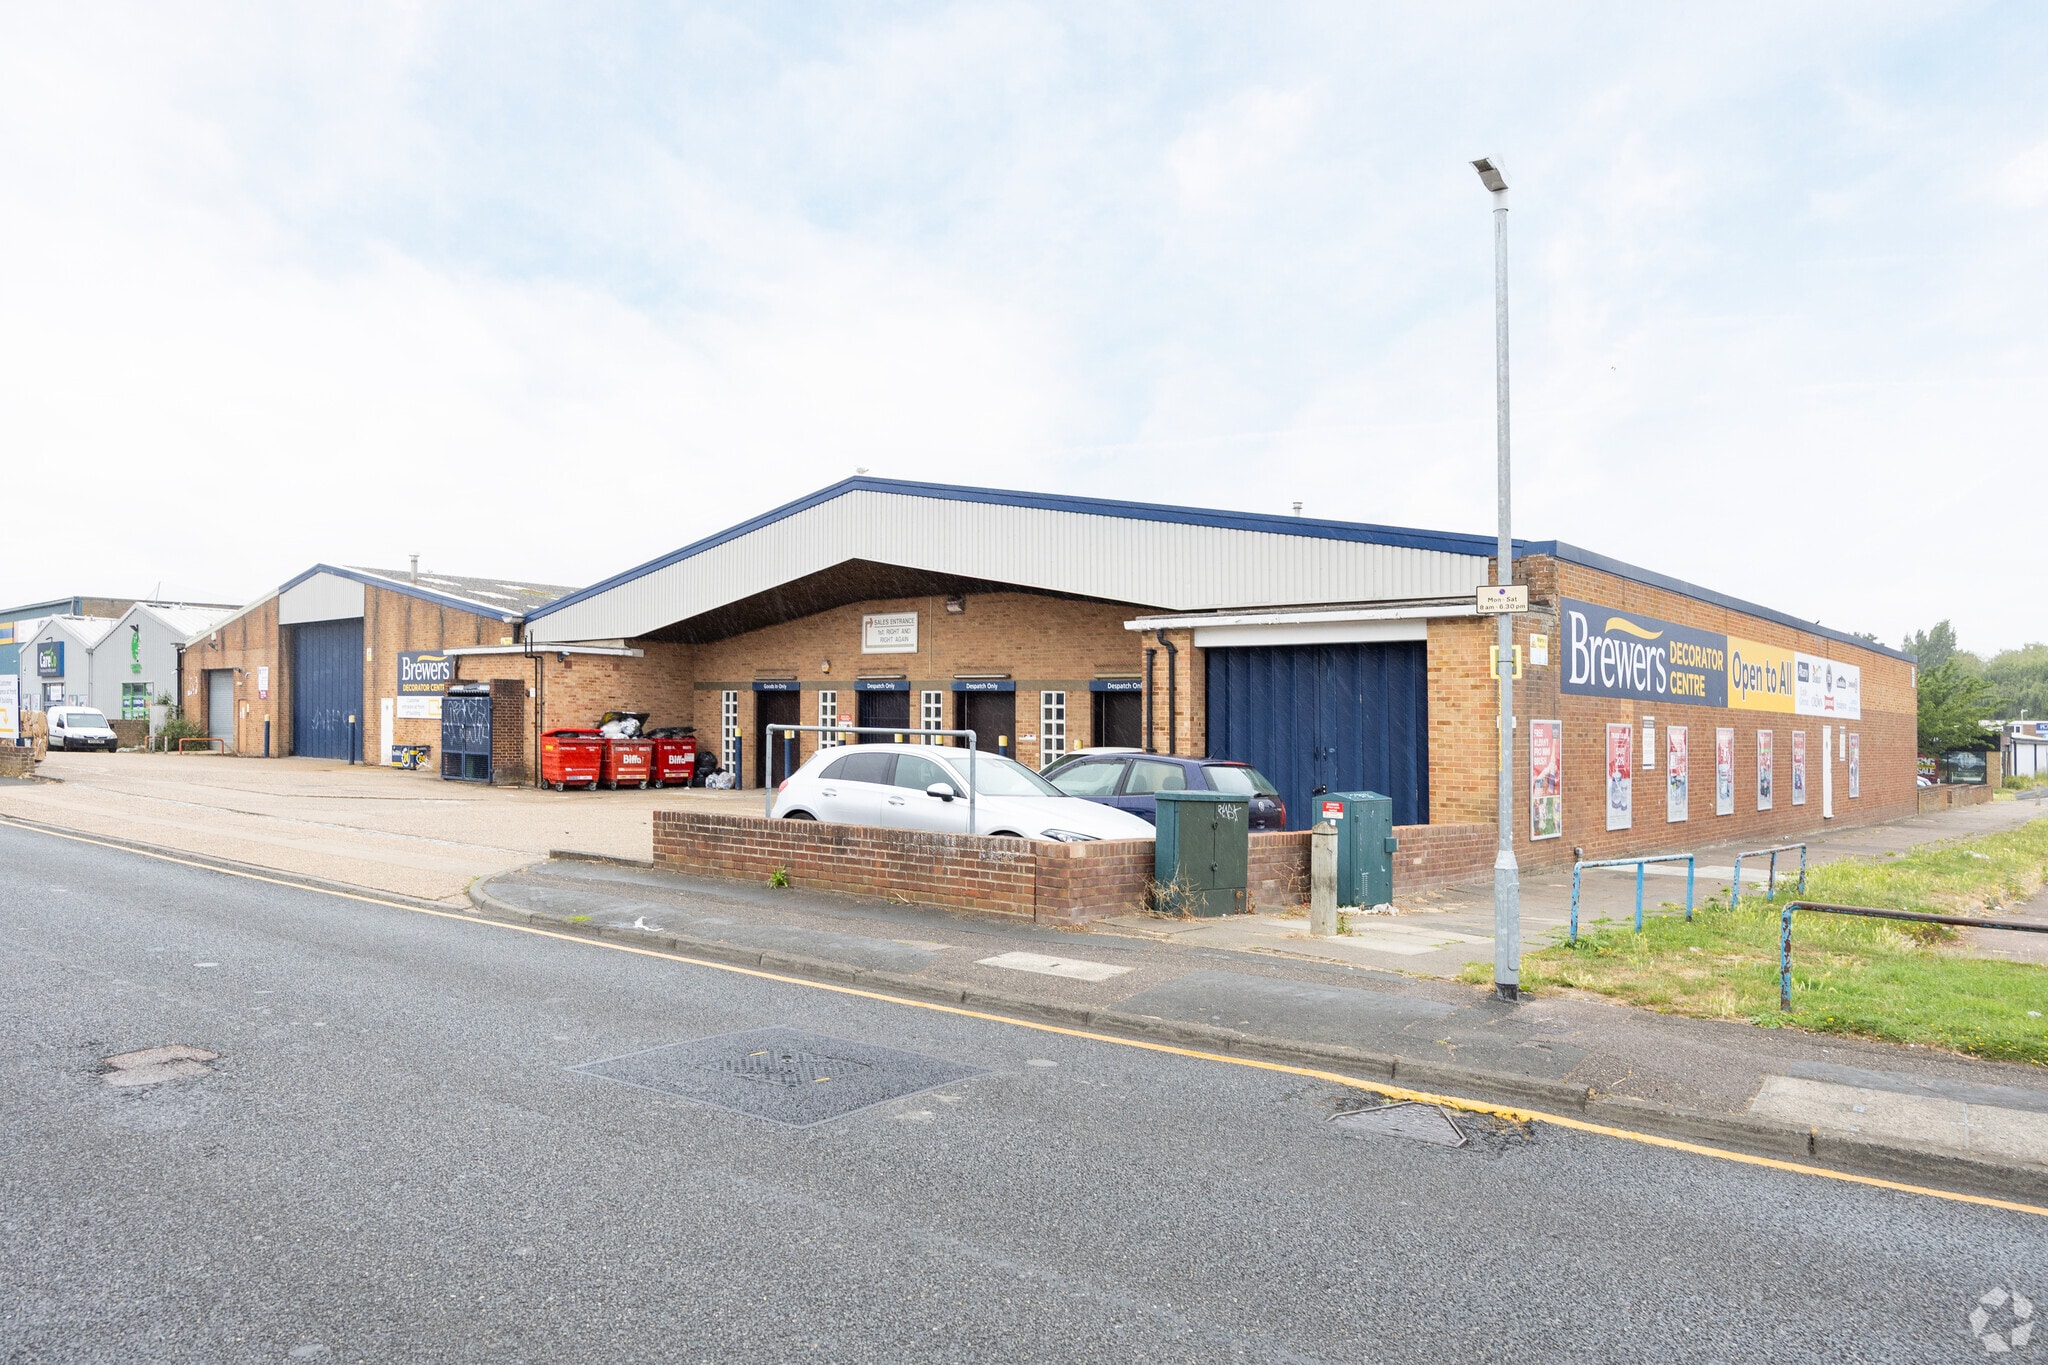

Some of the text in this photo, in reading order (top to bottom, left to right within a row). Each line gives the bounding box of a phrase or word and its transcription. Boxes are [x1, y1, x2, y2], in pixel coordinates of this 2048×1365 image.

[874, 617, 915, 626] SALES ENTRANCE
[901, 627, 911, 635] AND
[1568, 610, 1724, 694] Brewers DECORATOR
[401, 656, 450, 681] Brewers
[1732, 650, 1763, 701] Open
[1765, 659, 1777, 694] to
[1779, 660, 1793, 696] All
[402, 683, 430, 692] DECORATOR
[866, 682, 895, 690] Despatch Only
[966, 682, 998, 691] Despatch Only
[1107, 682, 1143, 691] Despatch Onl
[1669, 670, 1706, 697] CENTRE
[623, 754, 642, 764] Biffa
[668, 754, 686, 765] Biffa
